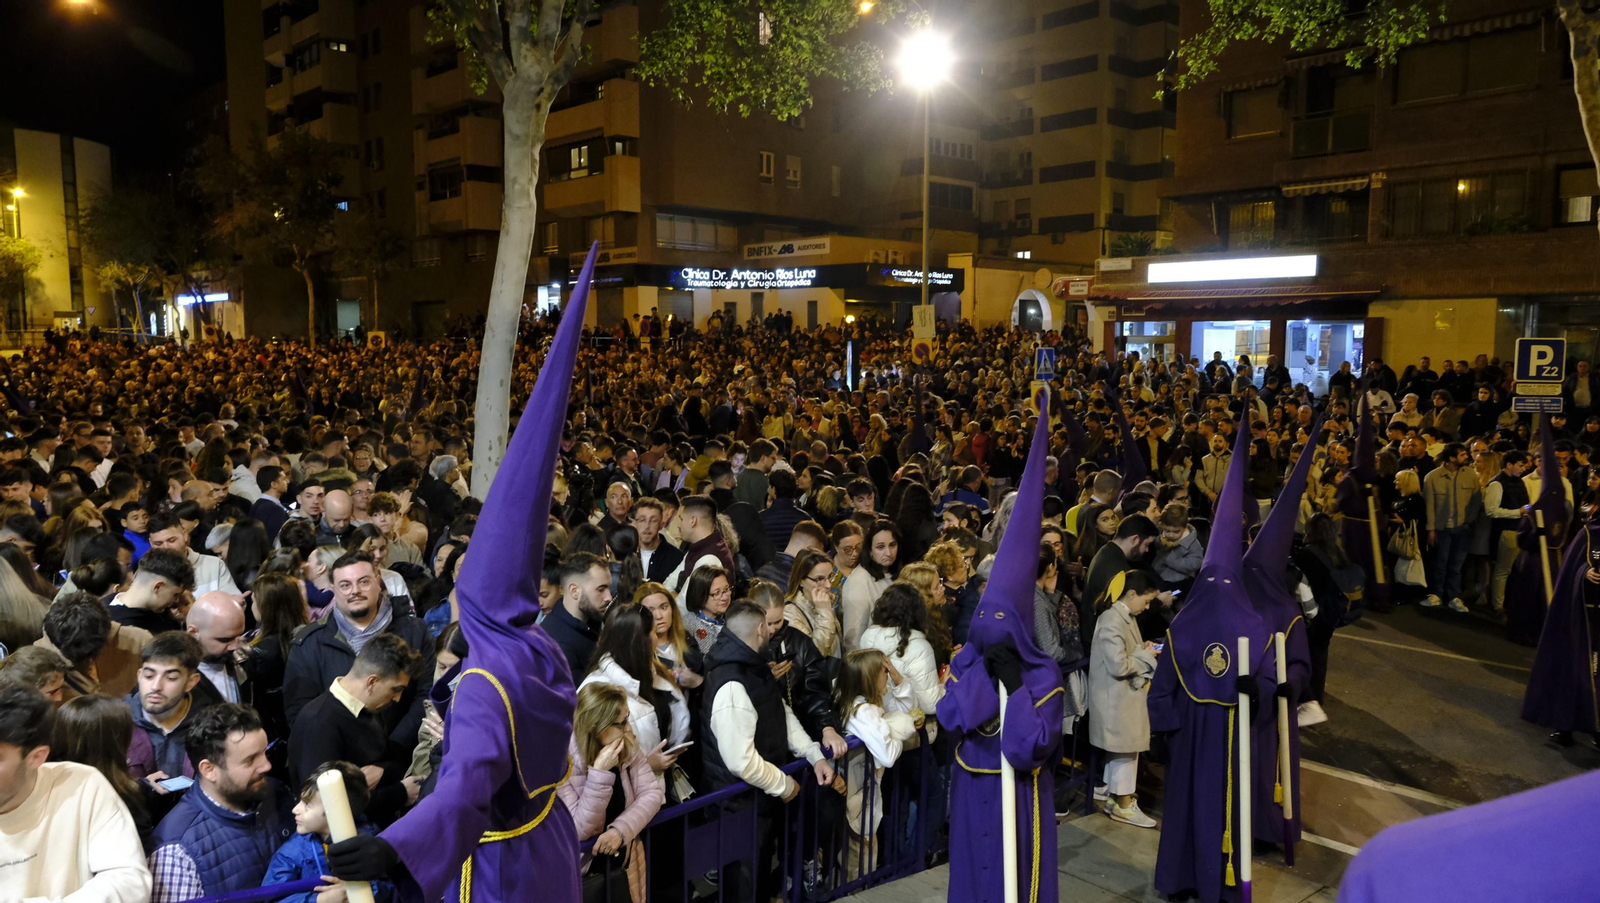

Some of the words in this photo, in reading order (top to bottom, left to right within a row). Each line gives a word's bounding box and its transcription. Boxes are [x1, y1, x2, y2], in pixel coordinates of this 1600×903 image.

[797, 242, 826, 251] AUDITORES
[712, 269, 728, 280] Dr.
[730, 269, 775, 280] Antonio
[794, 267, 816, 279] Luna
[740, 280, 746, 289] y
[1529, 344, 1555, 377] P
[1541, 366, 1559, 377] Z2
